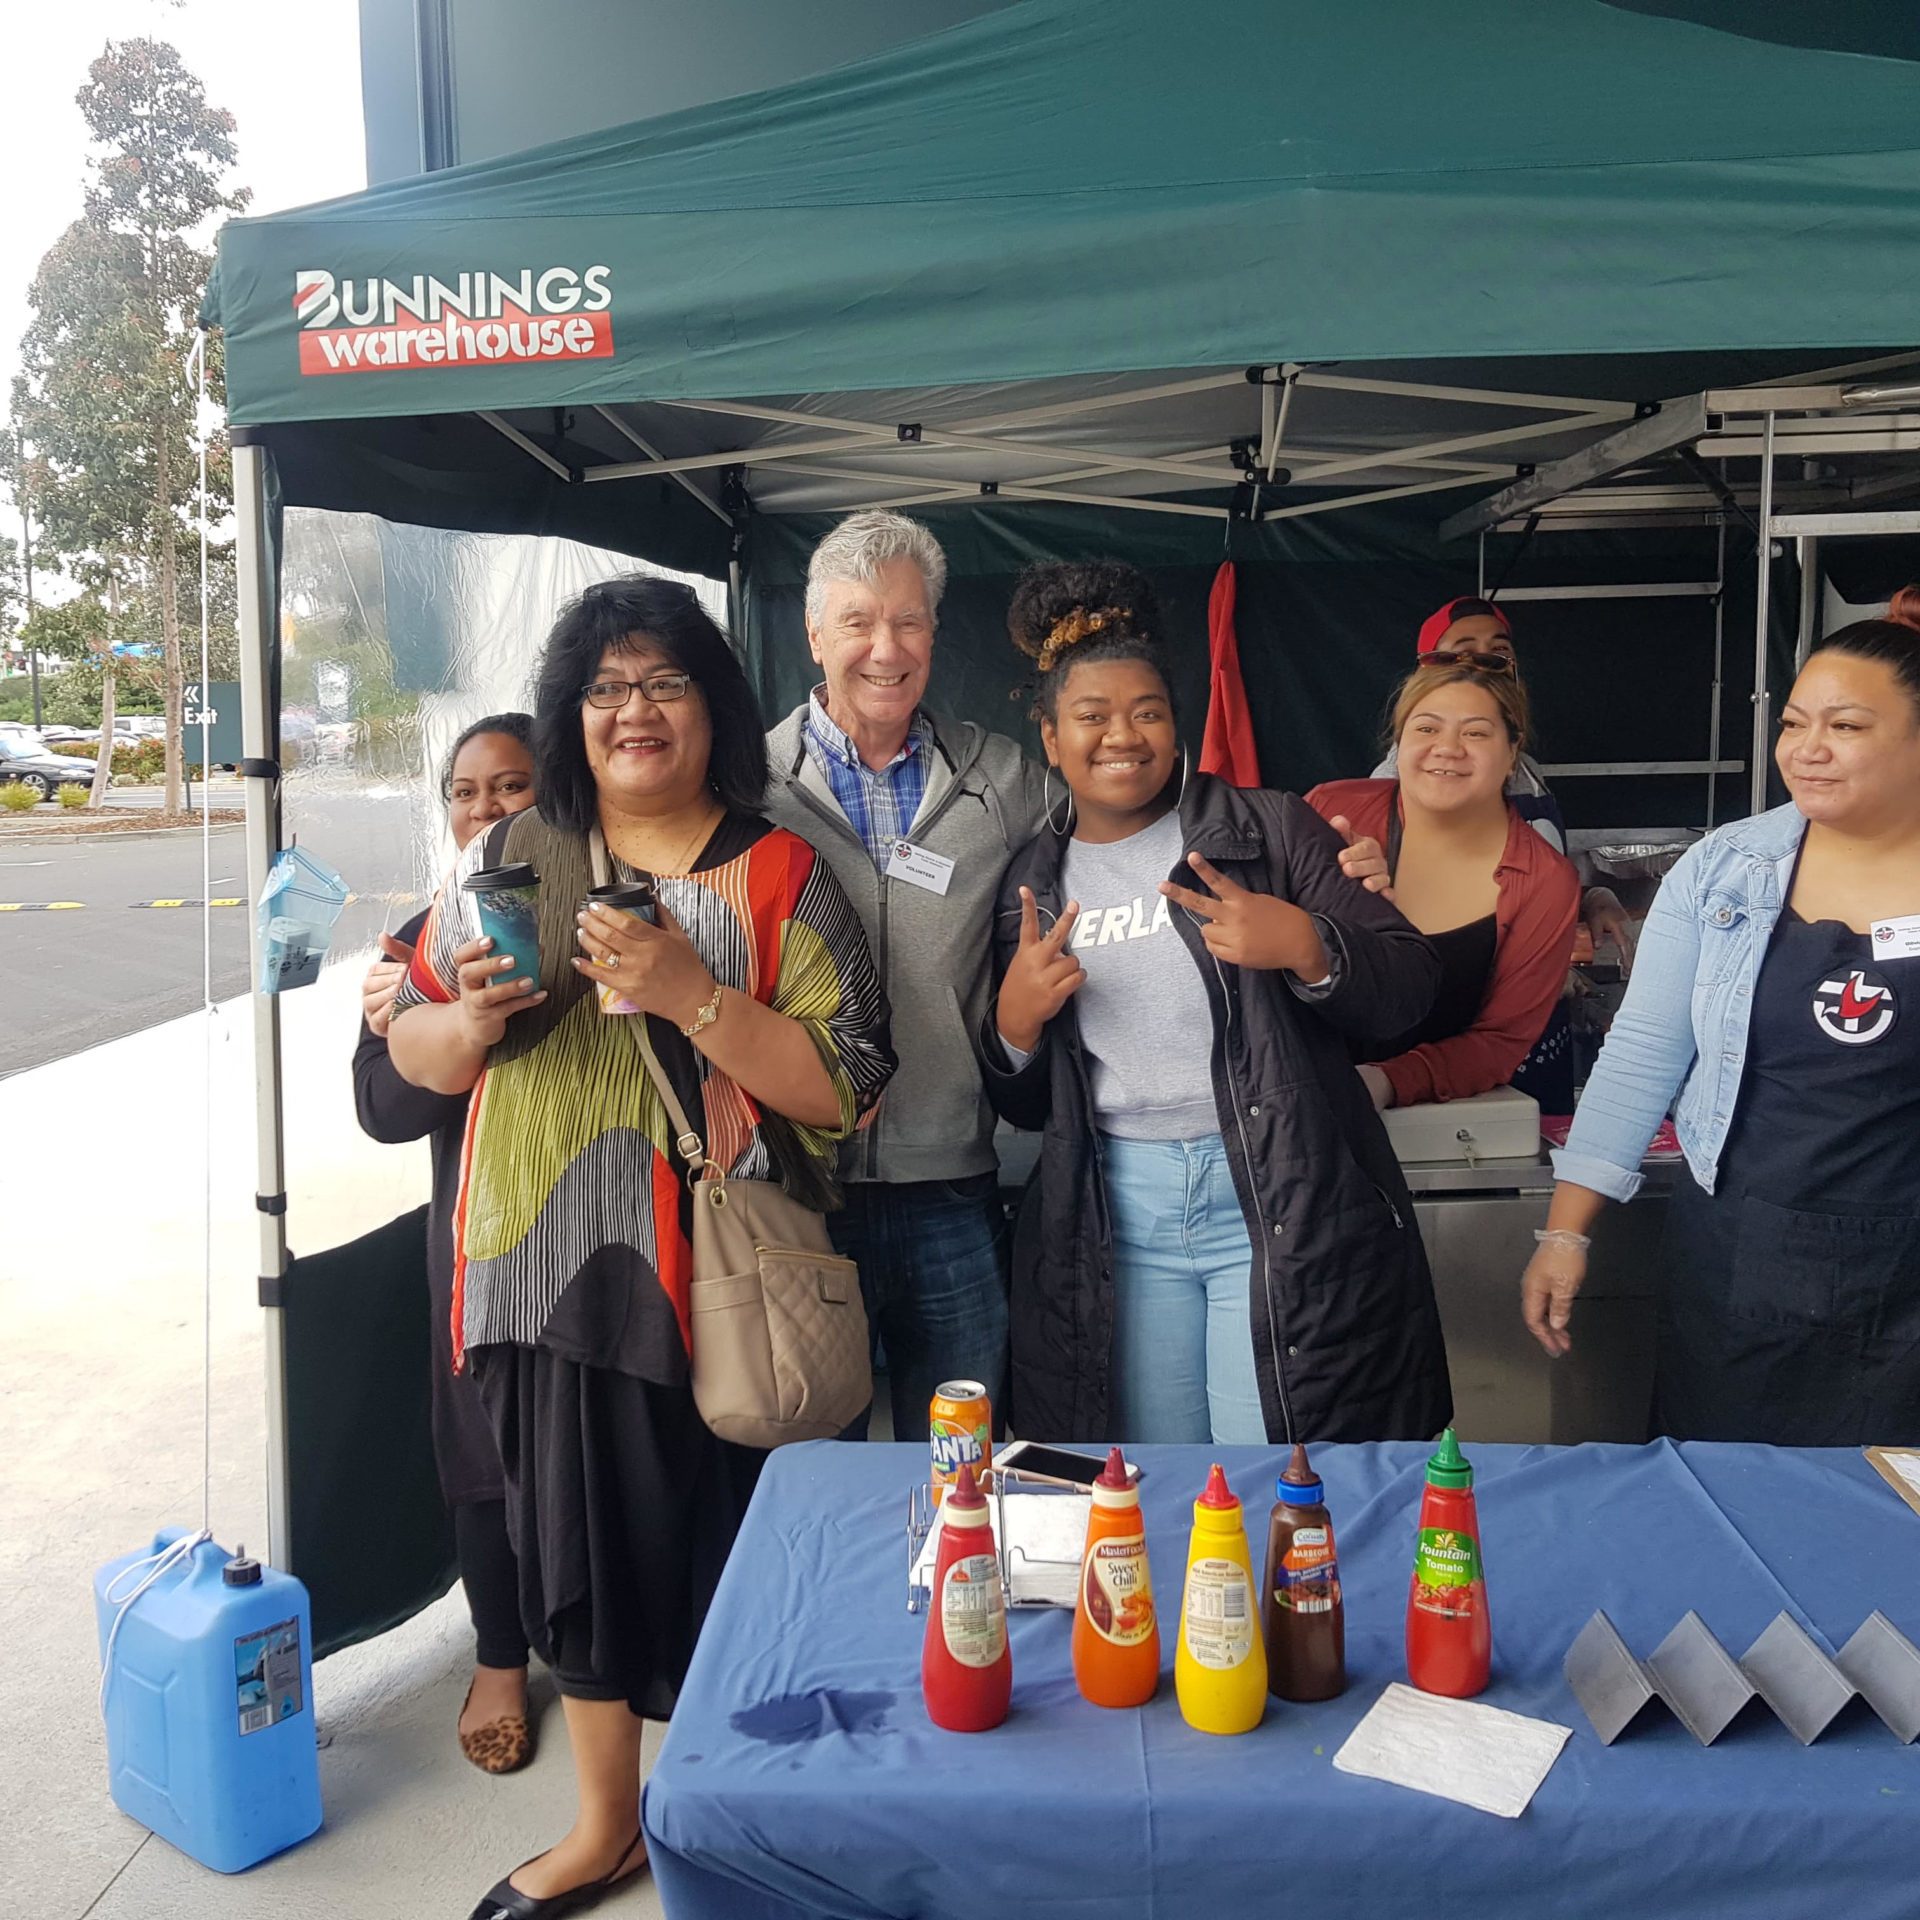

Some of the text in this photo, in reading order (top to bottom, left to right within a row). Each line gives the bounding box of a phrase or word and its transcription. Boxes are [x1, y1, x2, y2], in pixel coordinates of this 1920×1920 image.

[294, 265, 612, 328] BUNNINGS
[317, 309, 595, 369] warehouse
[183, 706, 218, 725] Exit
[905, 865, 936, 879] VOLUNTEER
[1420, 1541, 1471, 1561] Fountain
[1108, 1560, 1140, 1575] Sweet
[1425, 1557, 1465, 1573] Tomato
[1112, 1573, 1138, 1588] Chilli
